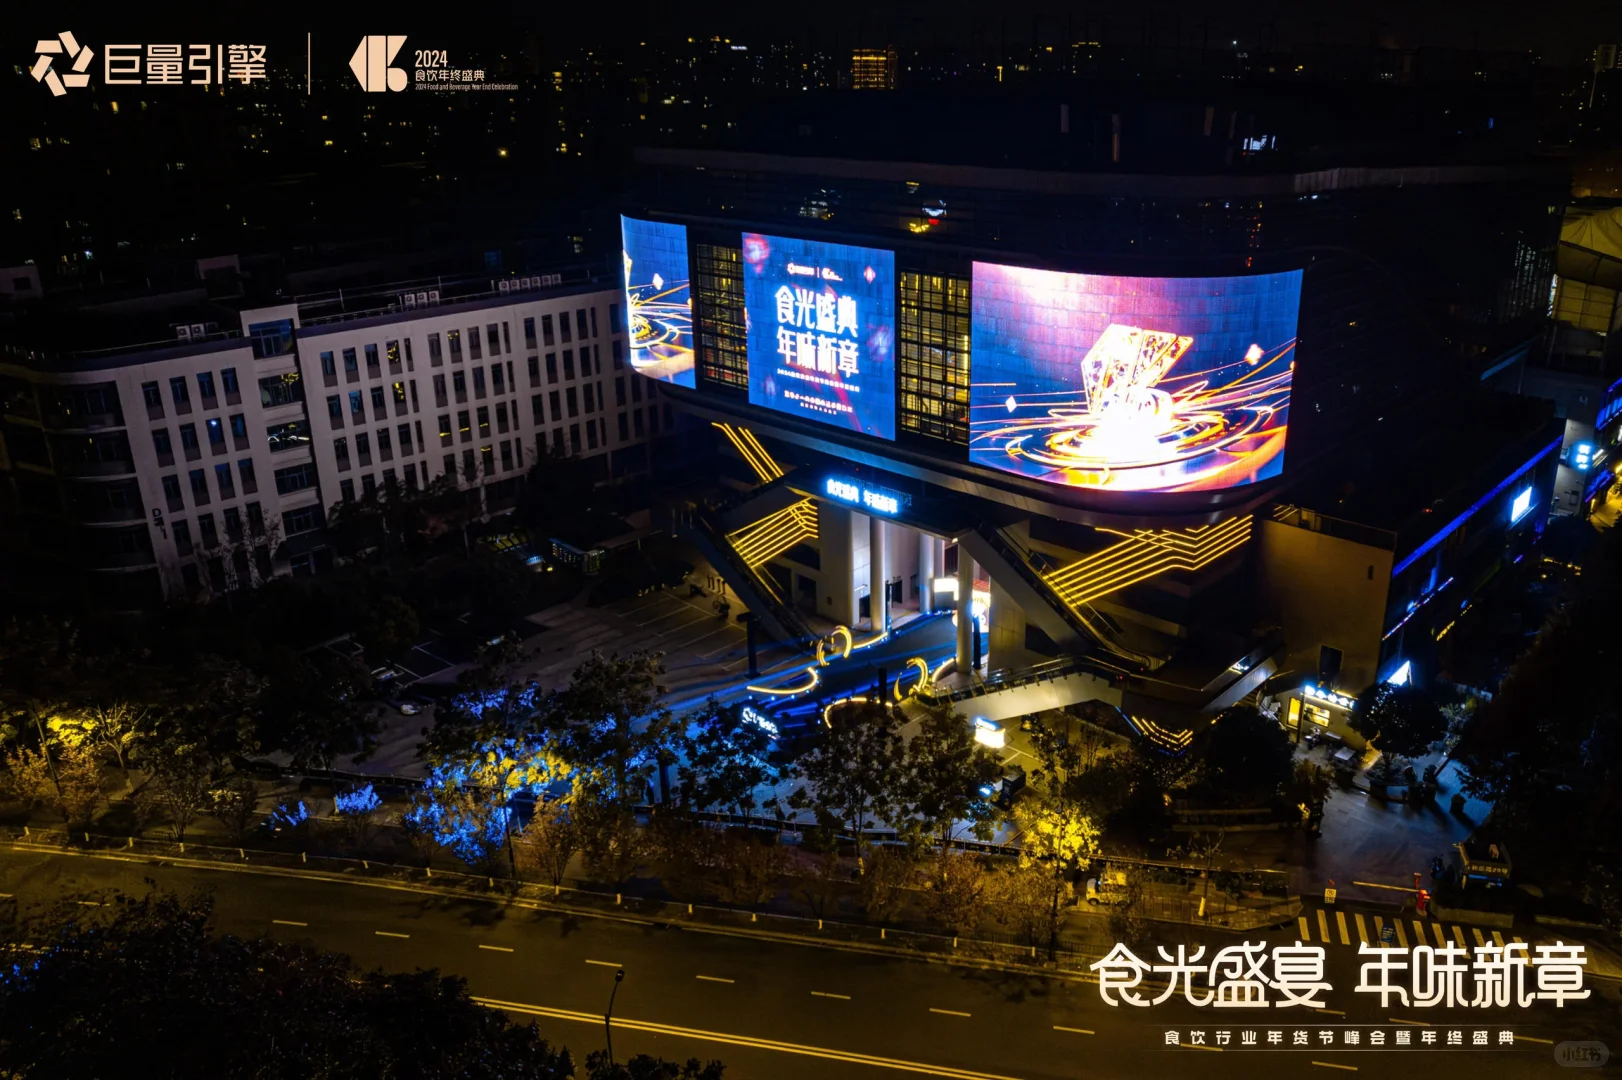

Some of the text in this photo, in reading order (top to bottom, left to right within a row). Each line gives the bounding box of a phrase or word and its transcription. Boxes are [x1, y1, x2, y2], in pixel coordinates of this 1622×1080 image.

[774, 285, 858, 338] 食光盛典
[776, 326, 859, 378] 年味新章
